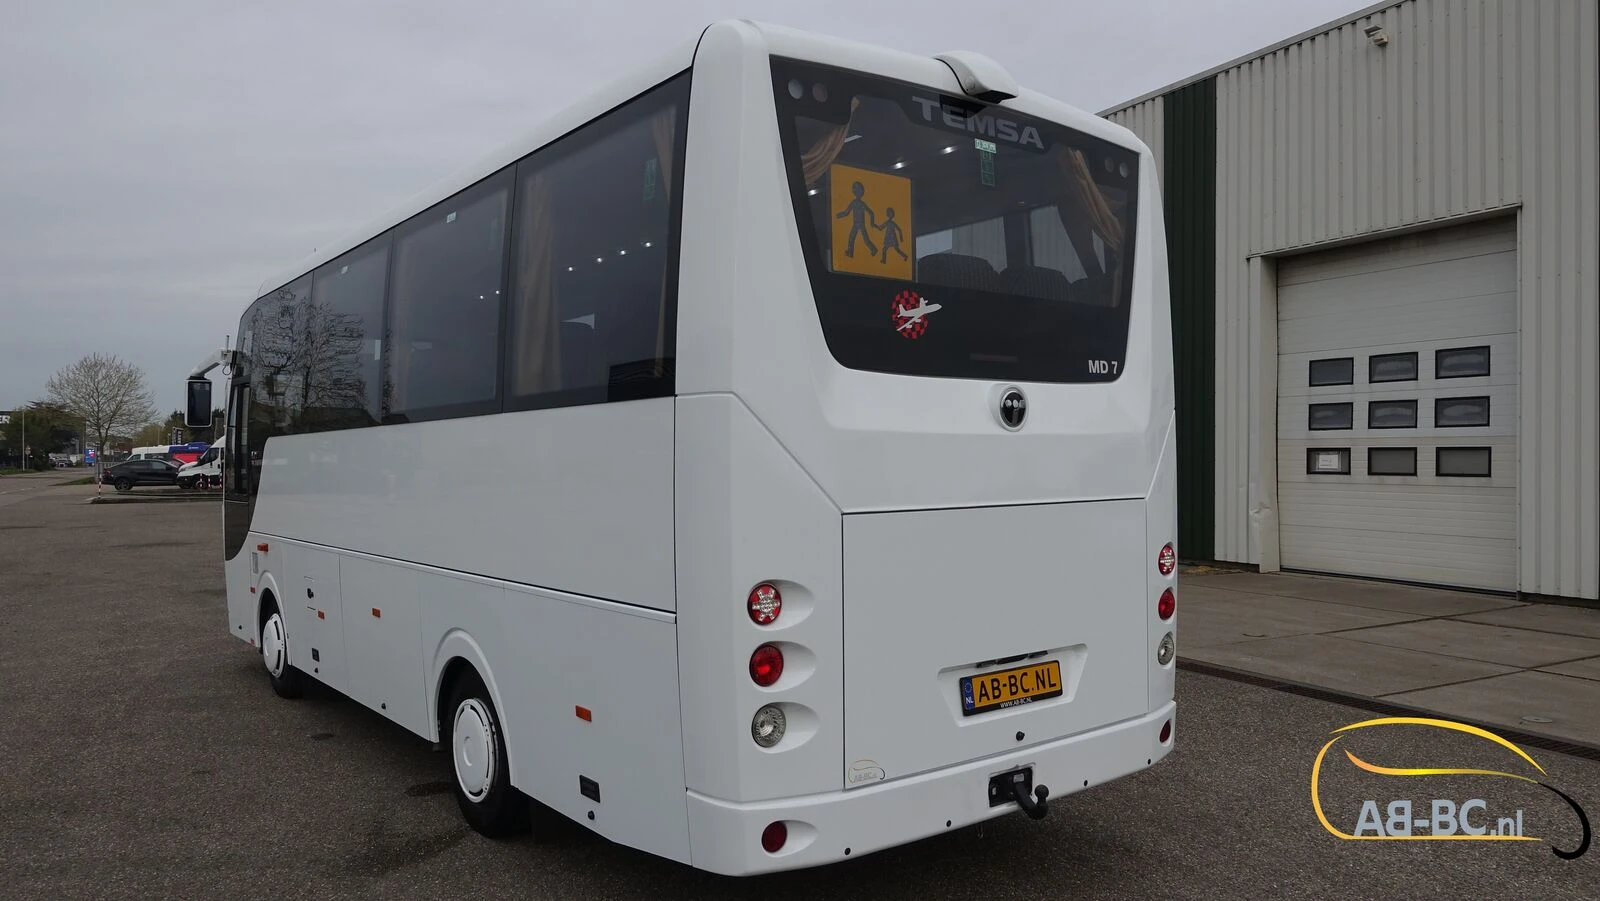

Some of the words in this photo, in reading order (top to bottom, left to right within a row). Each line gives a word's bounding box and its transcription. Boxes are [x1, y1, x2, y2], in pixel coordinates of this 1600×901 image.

[912, 95, 1045, 150] TEMSA
[1088, 359, 1109, 375] MD
[1111, 360, 1119, 376] 7
[978, 668, 1056, 702] AB-BC.NL
[965, 697, 974, 705] NL
